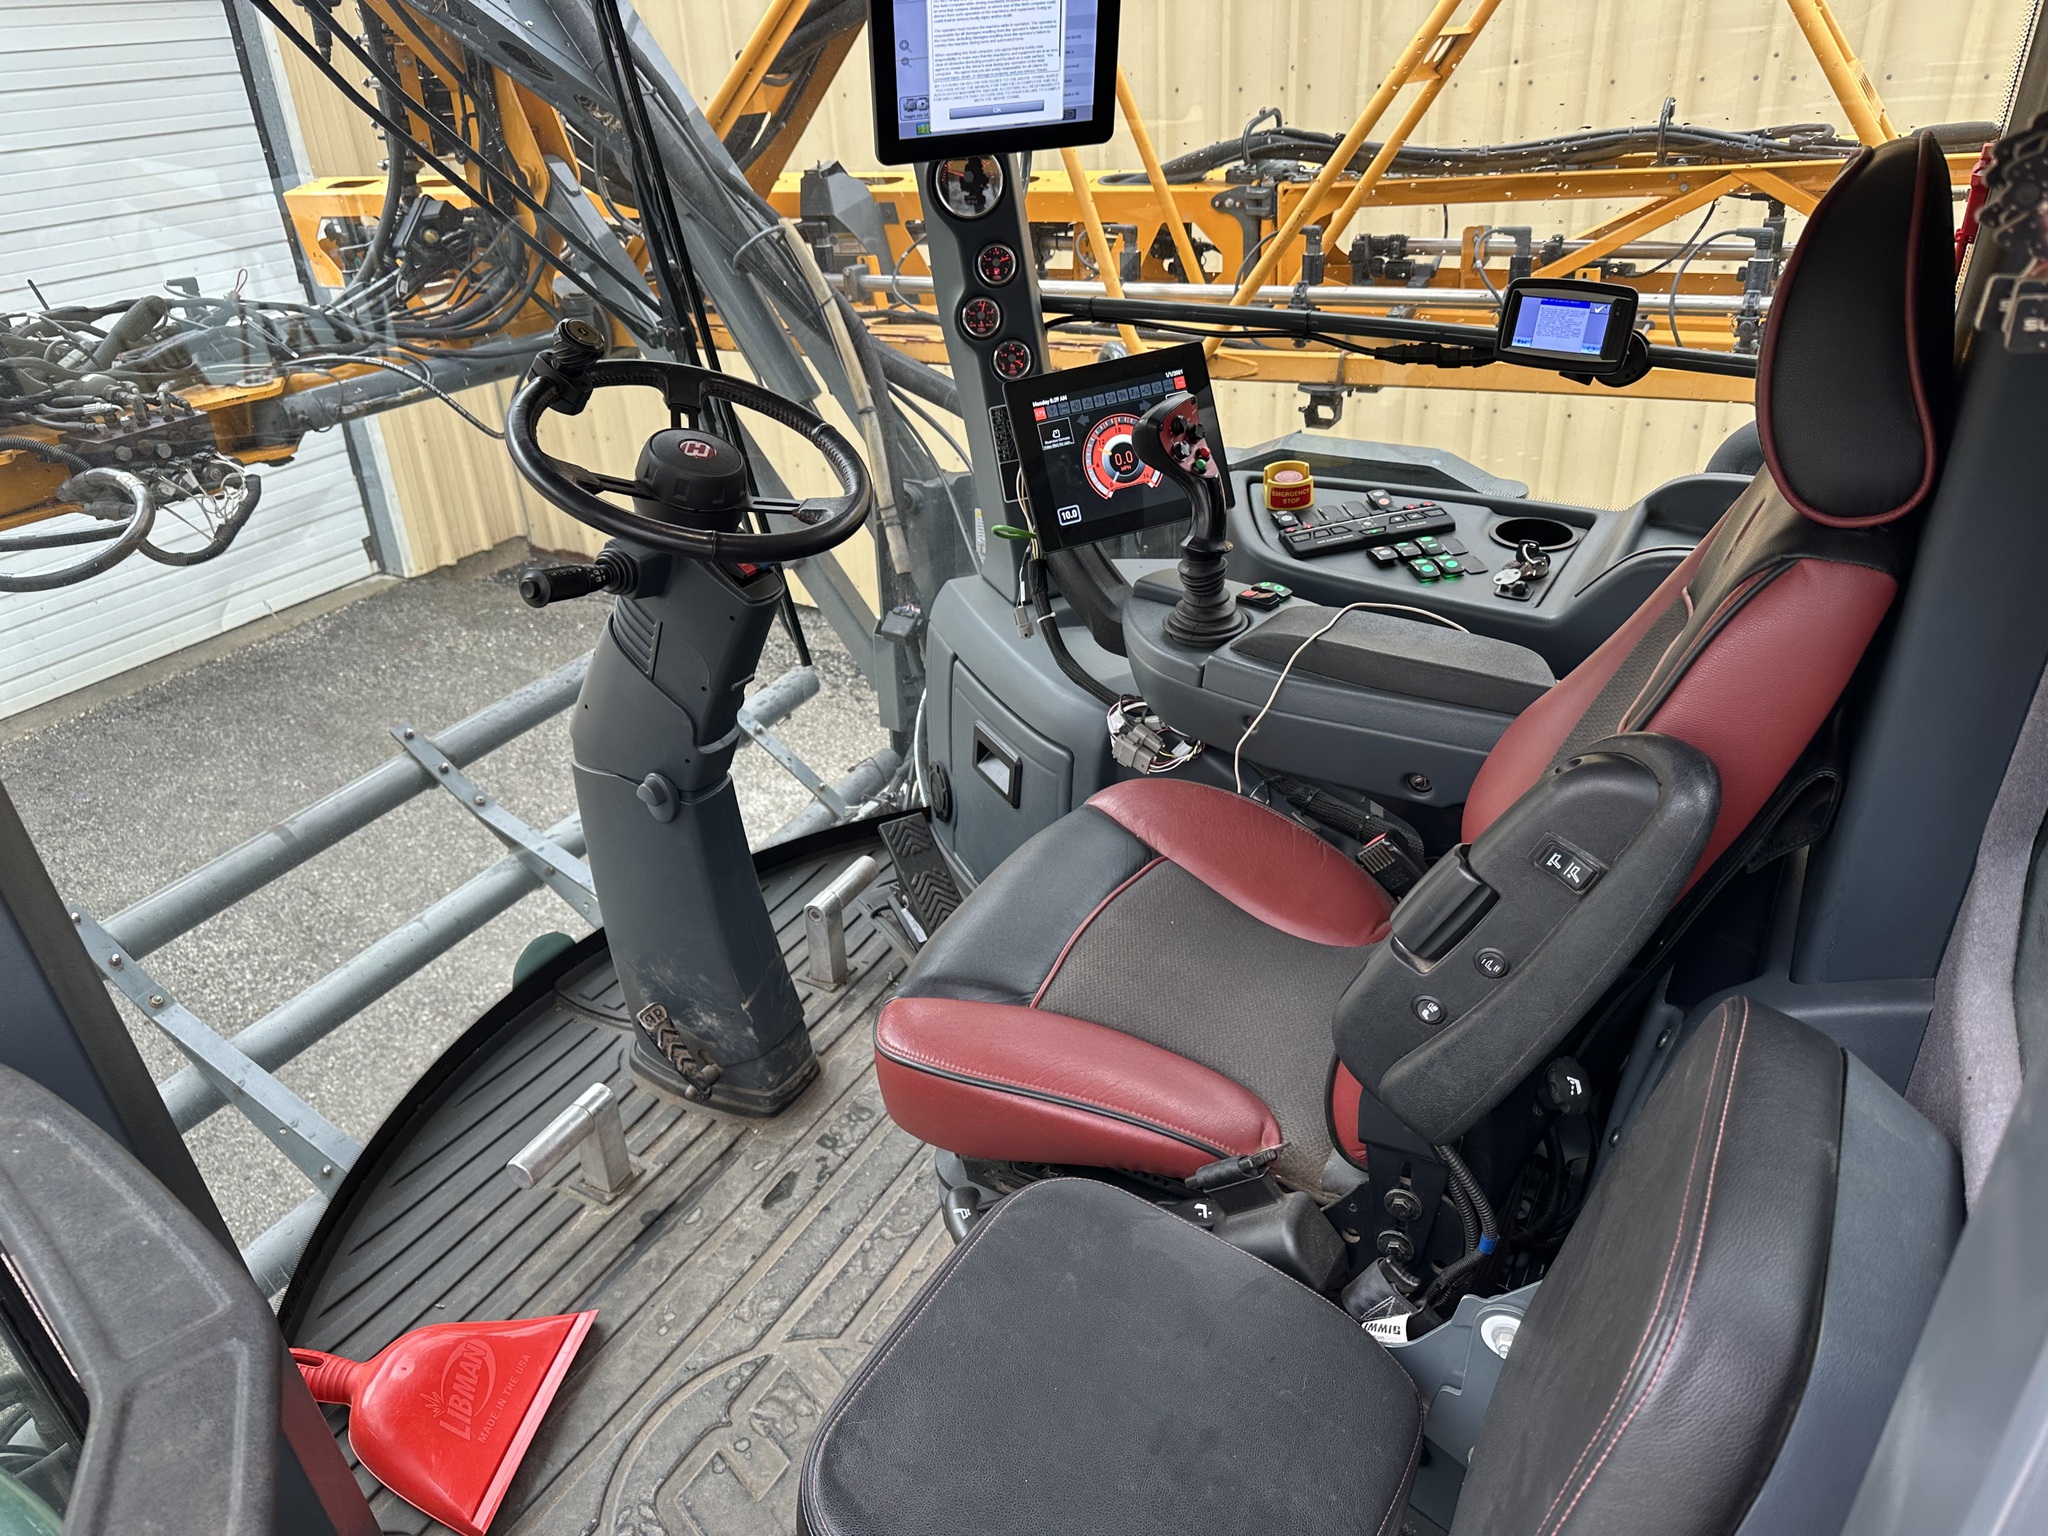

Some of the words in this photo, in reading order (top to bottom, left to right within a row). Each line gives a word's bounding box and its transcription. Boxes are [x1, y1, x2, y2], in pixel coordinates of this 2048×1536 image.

[1114, 450, 1133, 466] 0.0
[1272, 488, 1309, 497] EMERGENCY
[1061, 509, 1078, 521] 10.0
[438, 1342, 489, 1442] LIBMAN
[477, 1412, 499, 1444] MADE
[496, 1397, 508, 1411] IN
[503, 1375, 520, 1397] THE
[515, 1353, 532, 1375] USA
